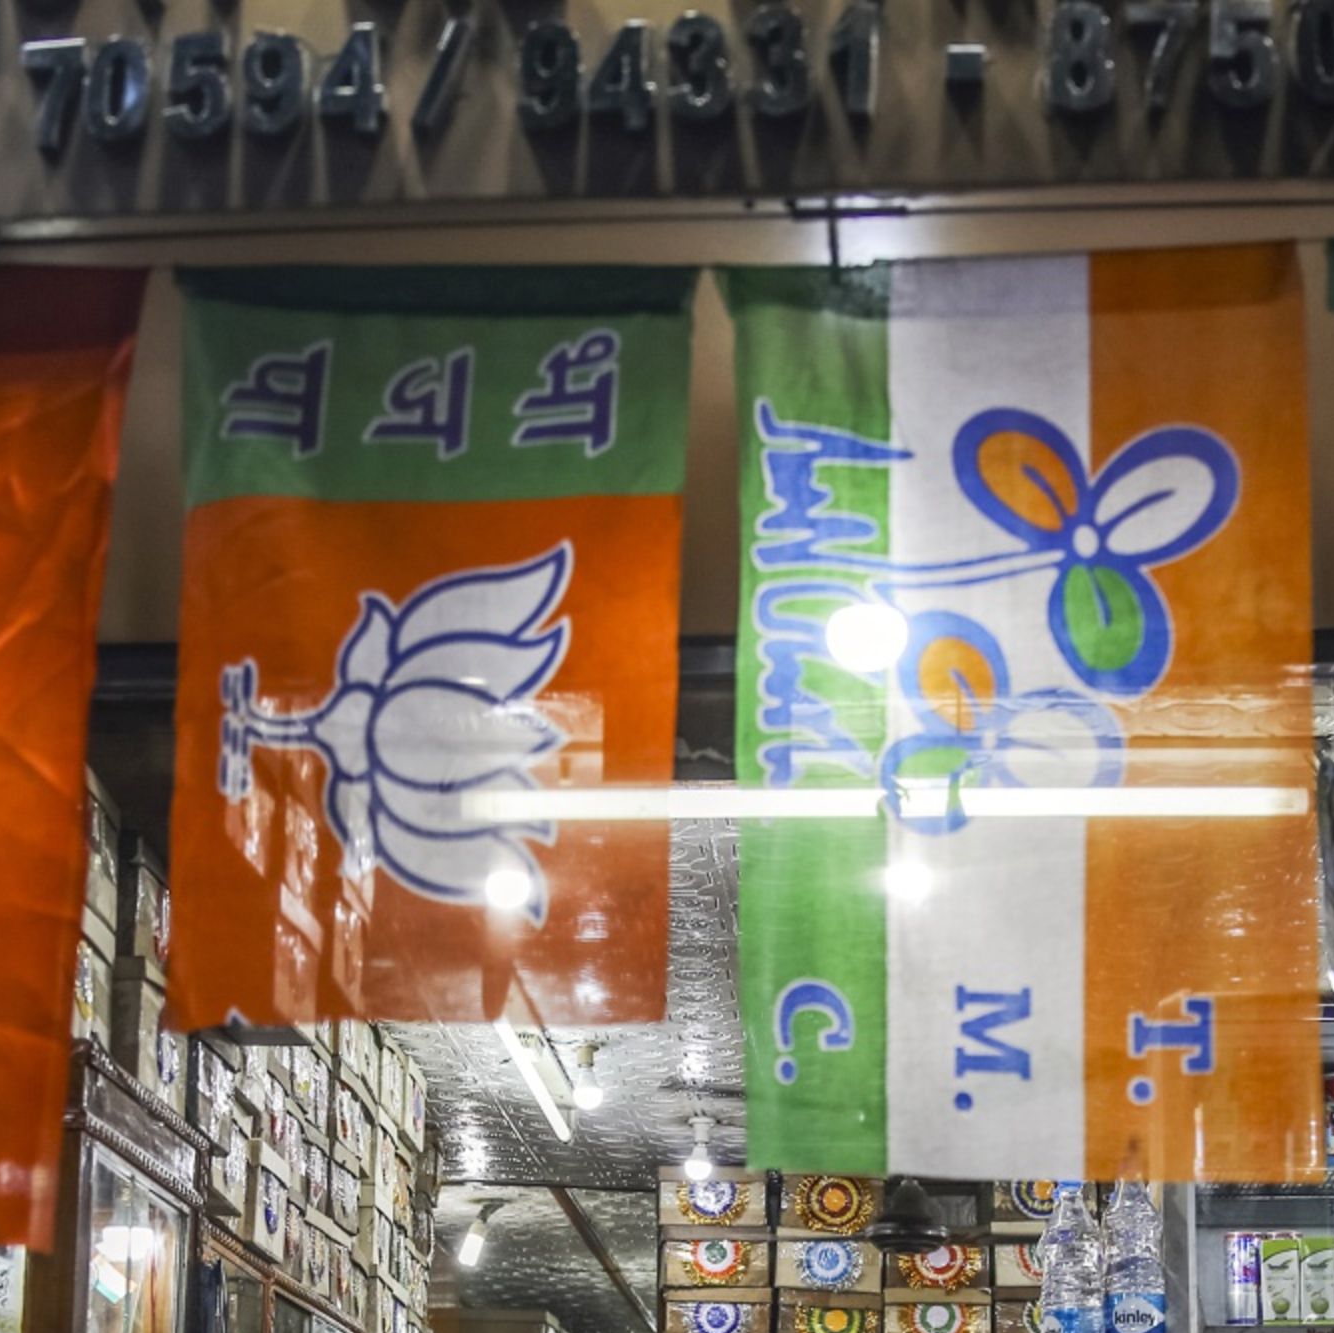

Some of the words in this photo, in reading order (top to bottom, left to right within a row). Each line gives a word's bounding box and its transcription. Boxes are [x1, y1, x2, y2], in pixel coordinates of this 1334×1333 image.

[22, 22, 389, 152] 70594
[517, 5, 879, 134] 94331
[1114, 1309, 1157, 1327] kinley
